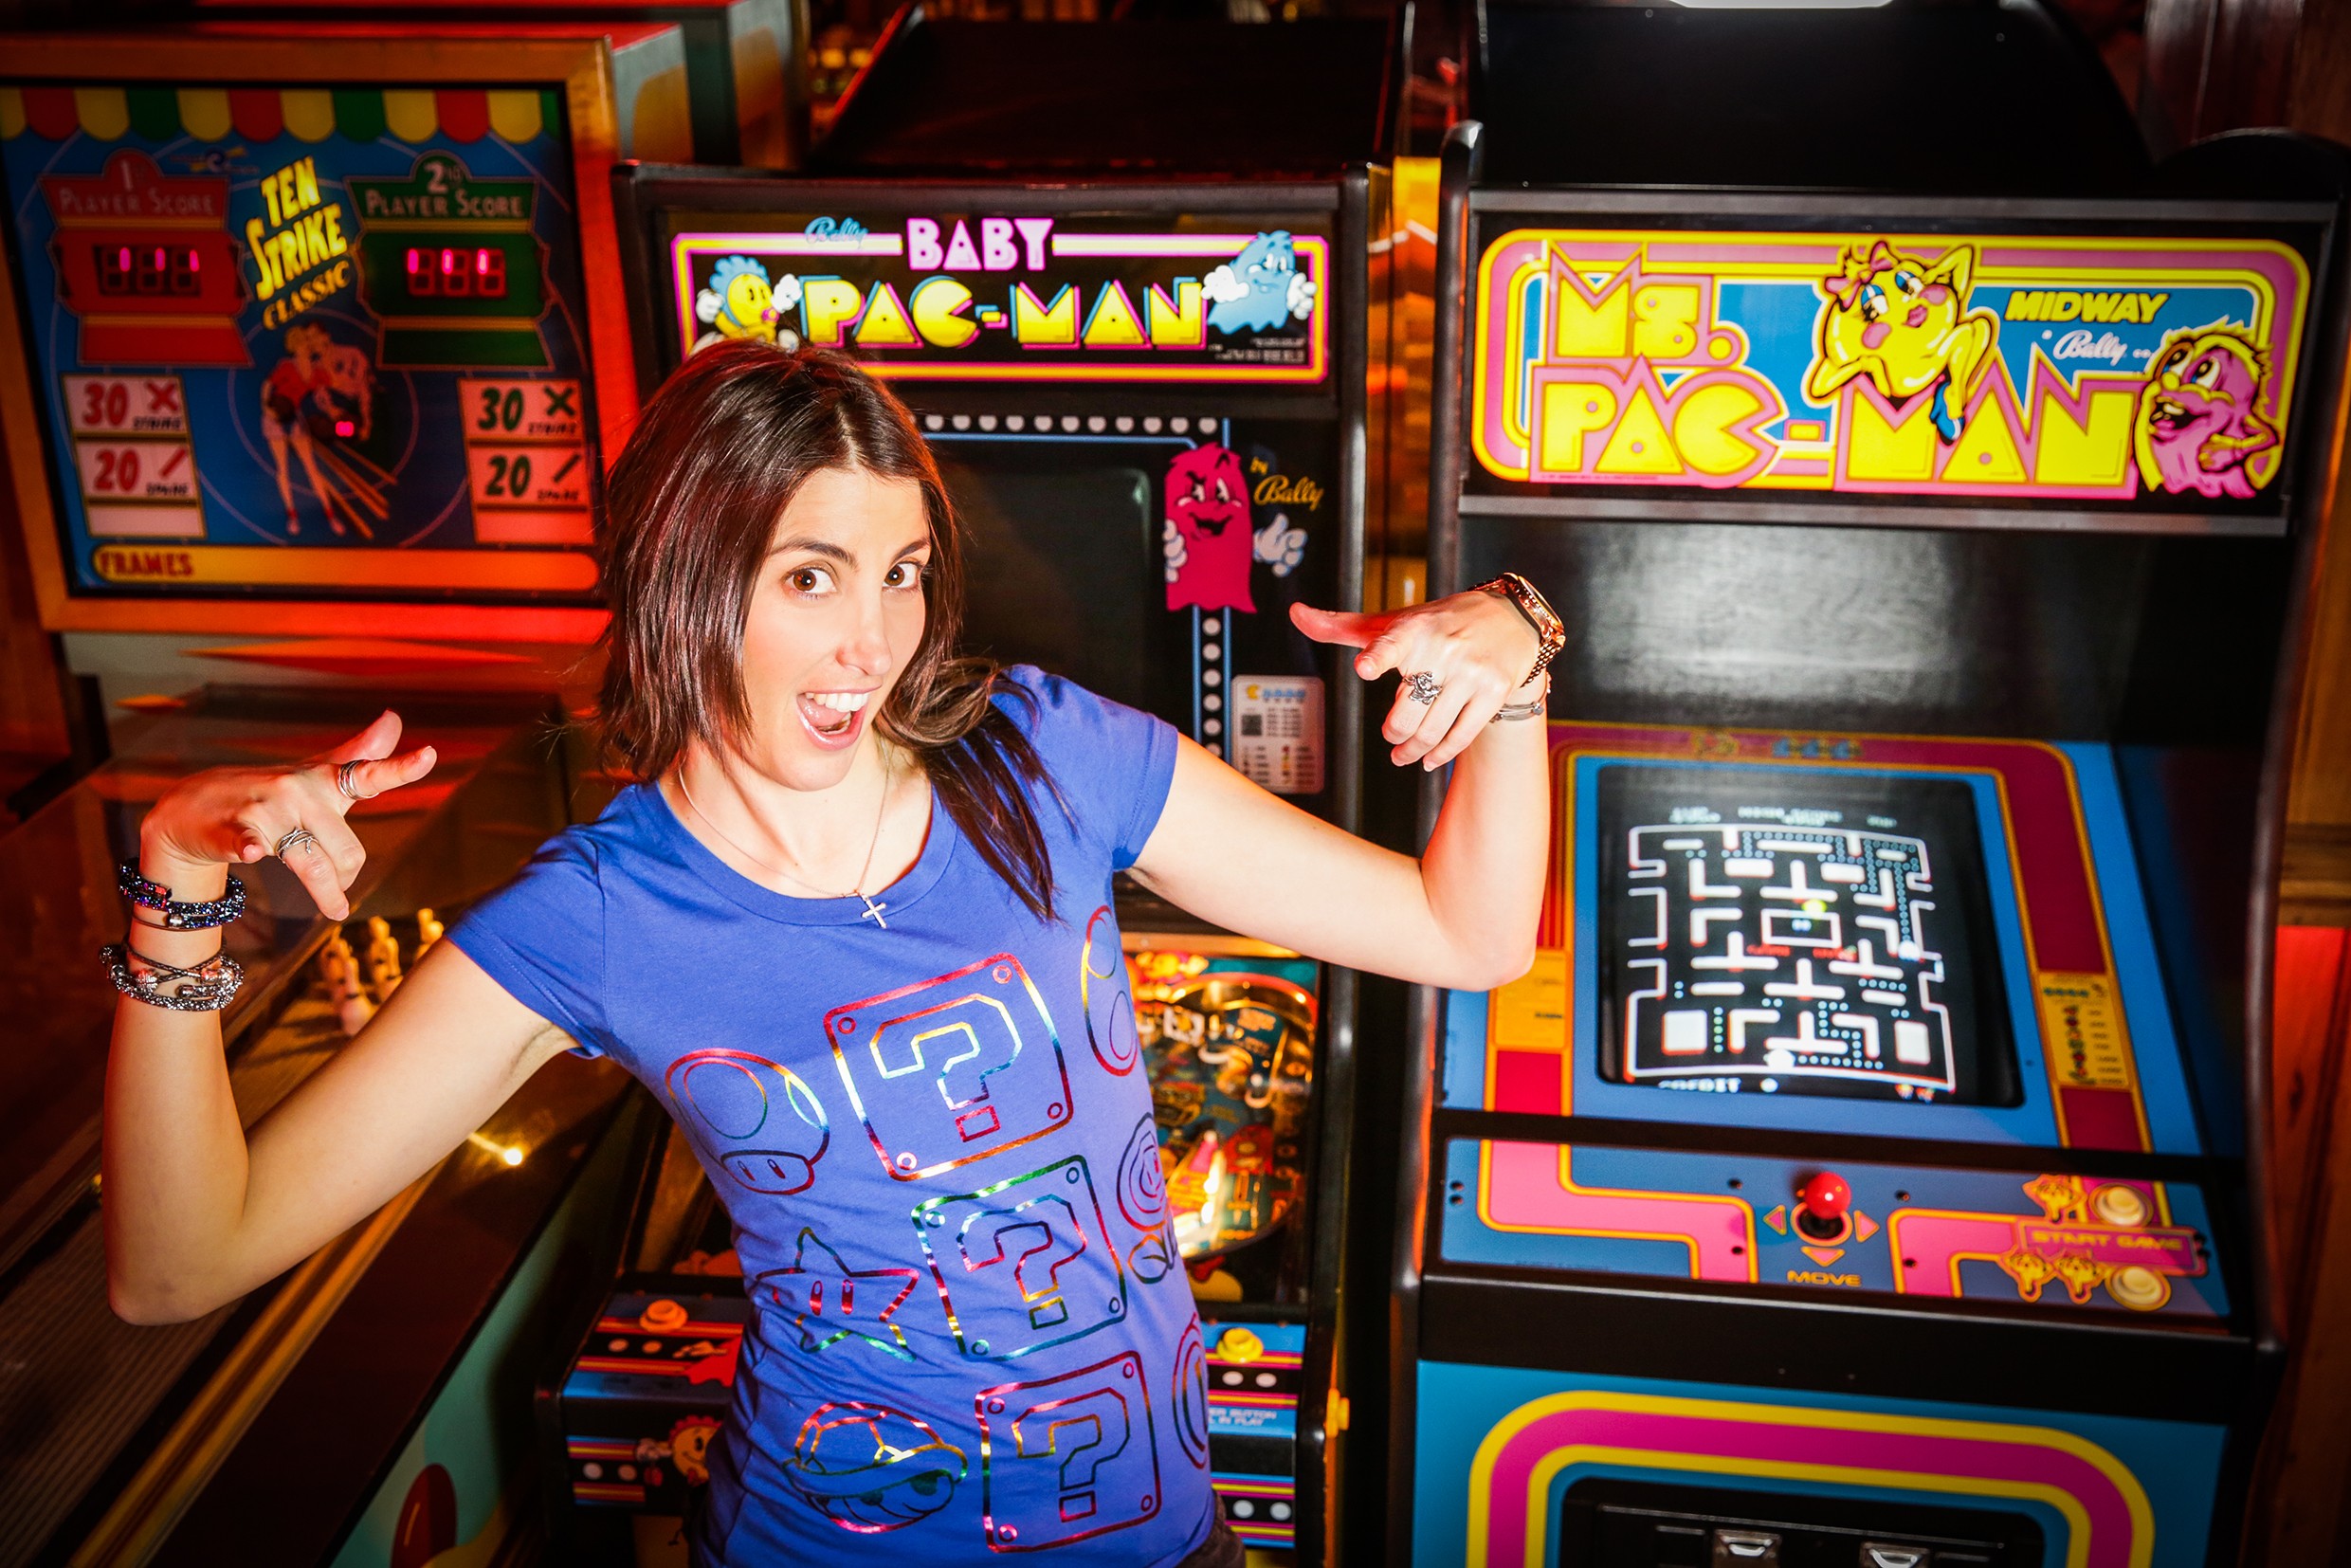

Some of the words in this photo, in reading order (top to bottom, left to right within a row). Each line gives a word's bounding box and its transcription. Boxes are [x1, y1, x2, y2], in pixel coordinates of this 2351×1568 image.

[261, 155, 320, 228] TEN
[246, 203, 347, 301] STRIKE
[804, 216, 868, 249] Bally
[906, 217, 1054, 271] BABY
[263, 261, 350, 330] CLASSIC
[799, 275, 1207, 351] PAC-MAN
[2003, 289, 2171, 324] MIDWAY
[2052, 329, 2127, 367] Bally
[82, 382, 128, 426] 30
[477, 387, 524, 431] 30
[1534, 365, 2137, 493] PAC-MAN
[94, 448, 139, 492] 20
[484, 454, 531, 498] 20
[1253, 474, 1324, 512] Bally
[98, 551, 193, 576] FRAMES
[2032, 1230, 2110, 1249] START
[2116, 1233, 2184, 1252] GAME
[1786, 1269, 1863, 1287] MOVE
